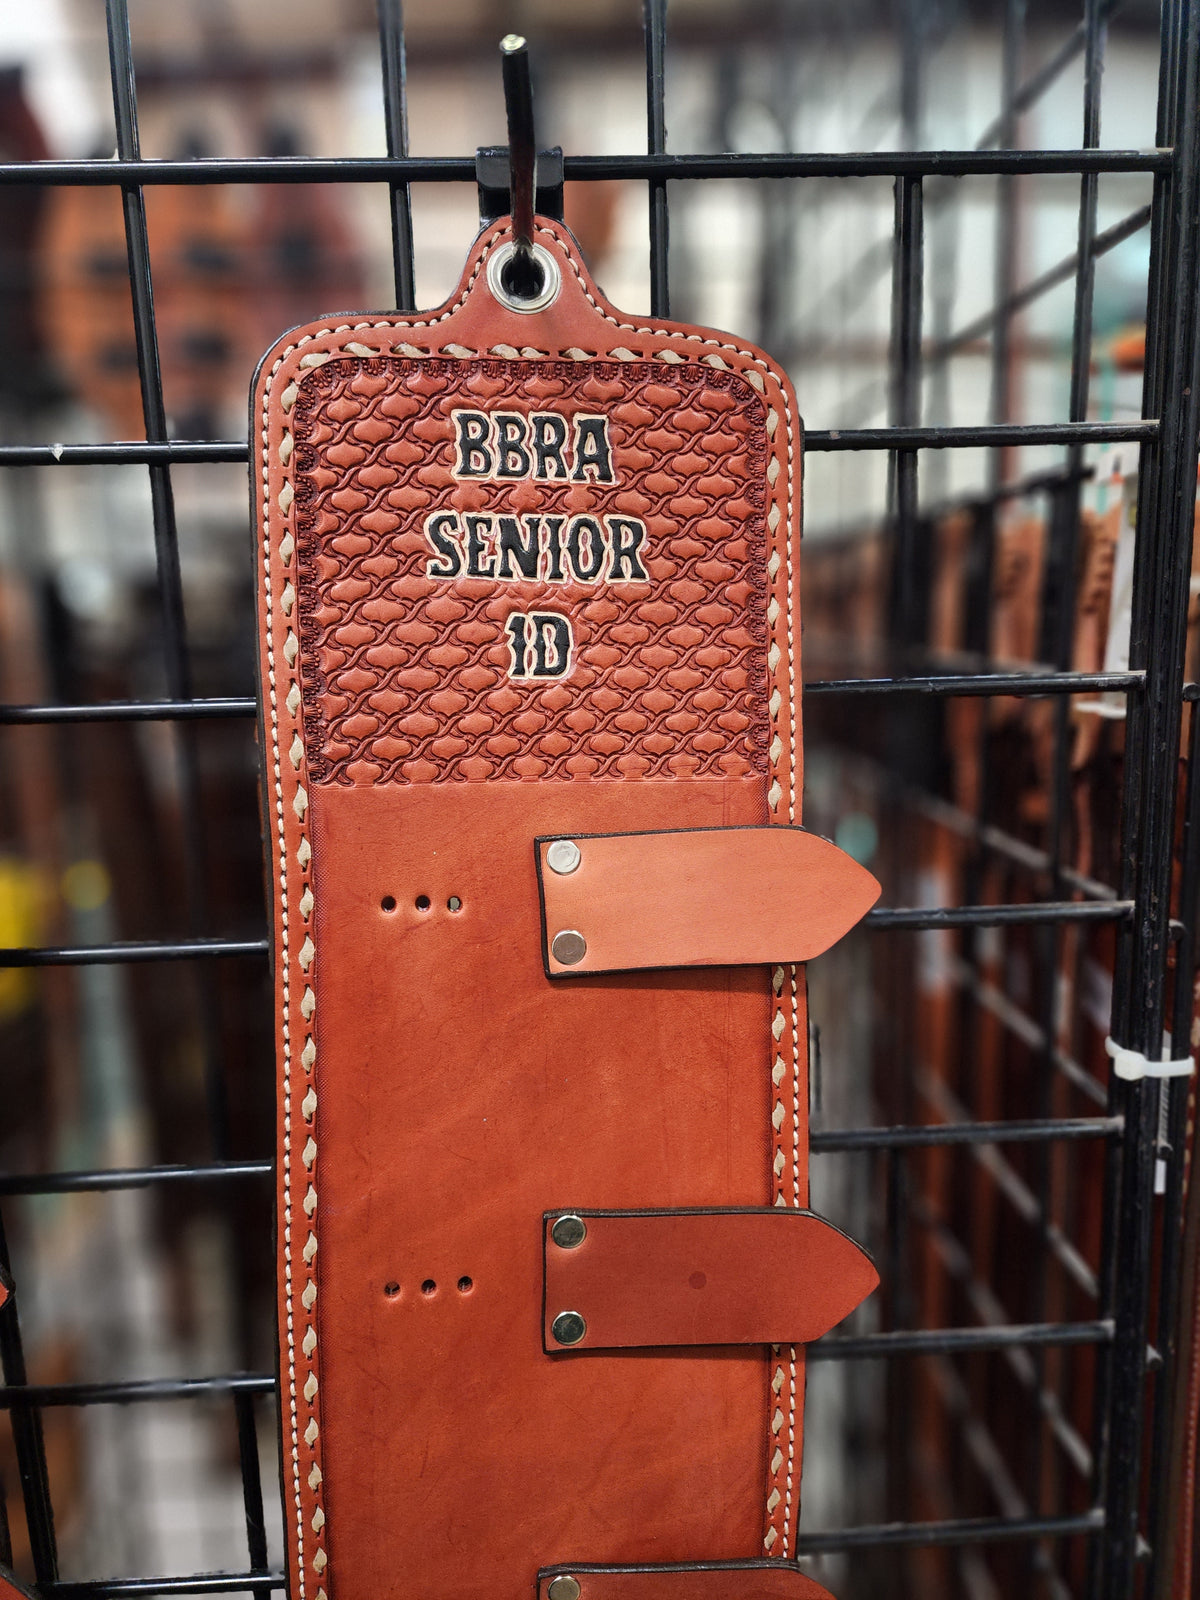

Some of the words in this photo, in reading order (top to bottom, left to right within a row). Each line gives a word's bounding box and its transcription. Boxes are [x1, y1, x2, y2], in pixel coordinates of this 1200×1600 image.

[452, 409, 615, 484] BBRA
[424, 511, 649, 584] SENIOR
[506, 612, 573, 679] 1D
